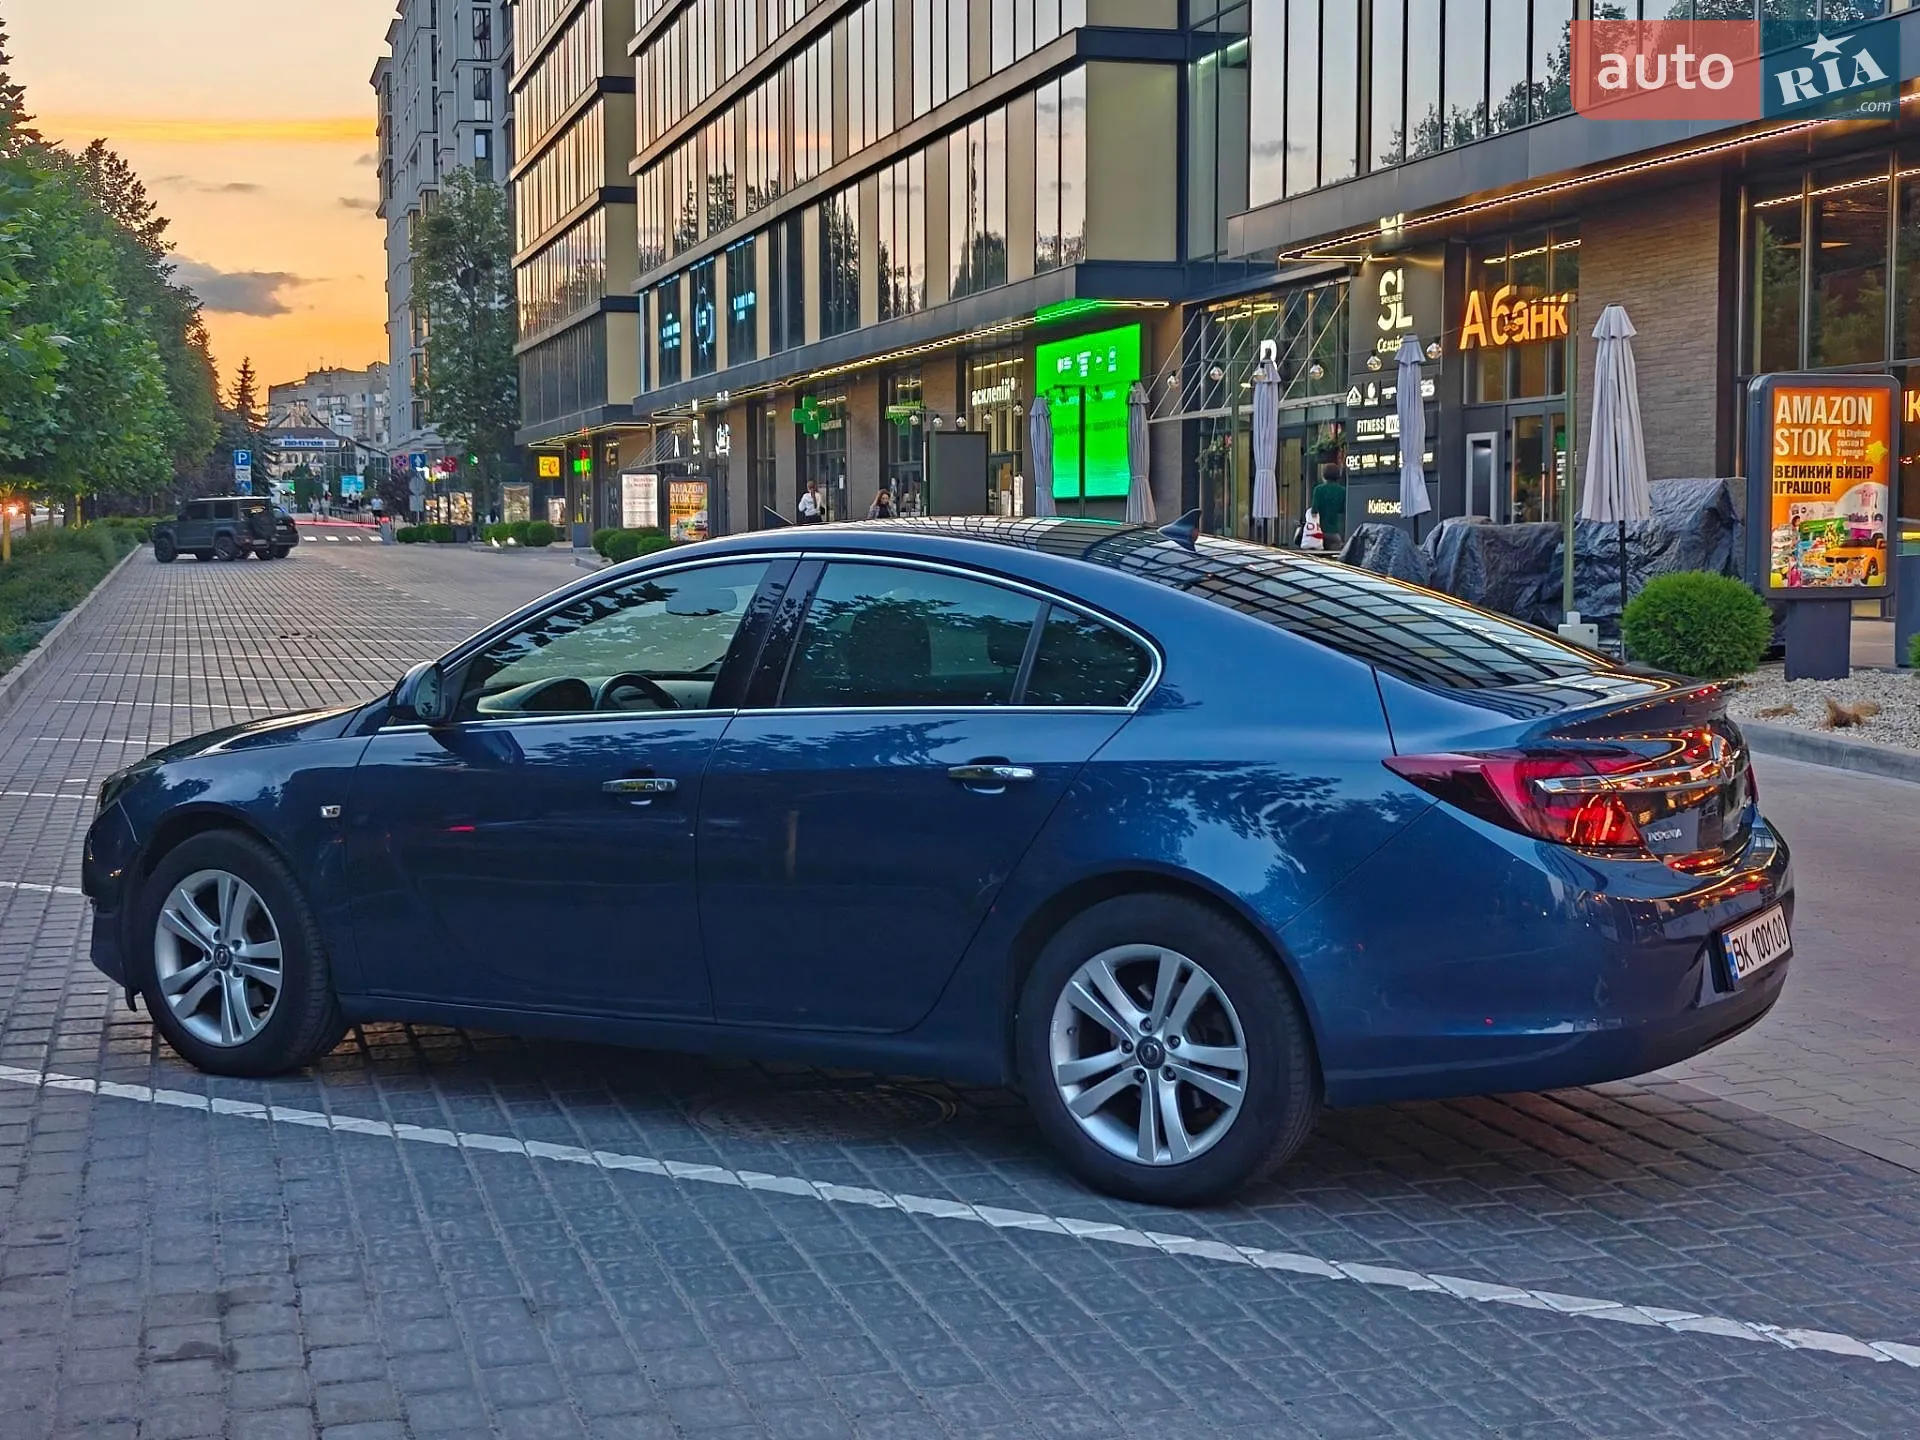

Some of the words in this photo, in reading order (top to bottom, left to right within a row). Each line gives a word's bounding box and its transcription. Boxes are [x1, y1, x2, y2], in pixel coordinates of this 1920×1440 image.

[1776, 395, 1873, 425] AMAZON
[1357, 418, 1385, 433] FITNESS
[1775, 427, 1832, 456] STOK
[238, 452, 247, 464] P
[1774, 462, 1833, 479] ВЕЛИКИЙ
[1835, 465, 1874, 479] ВИБІР
[1774, 480, 1831, 494] ІГРАШОК
